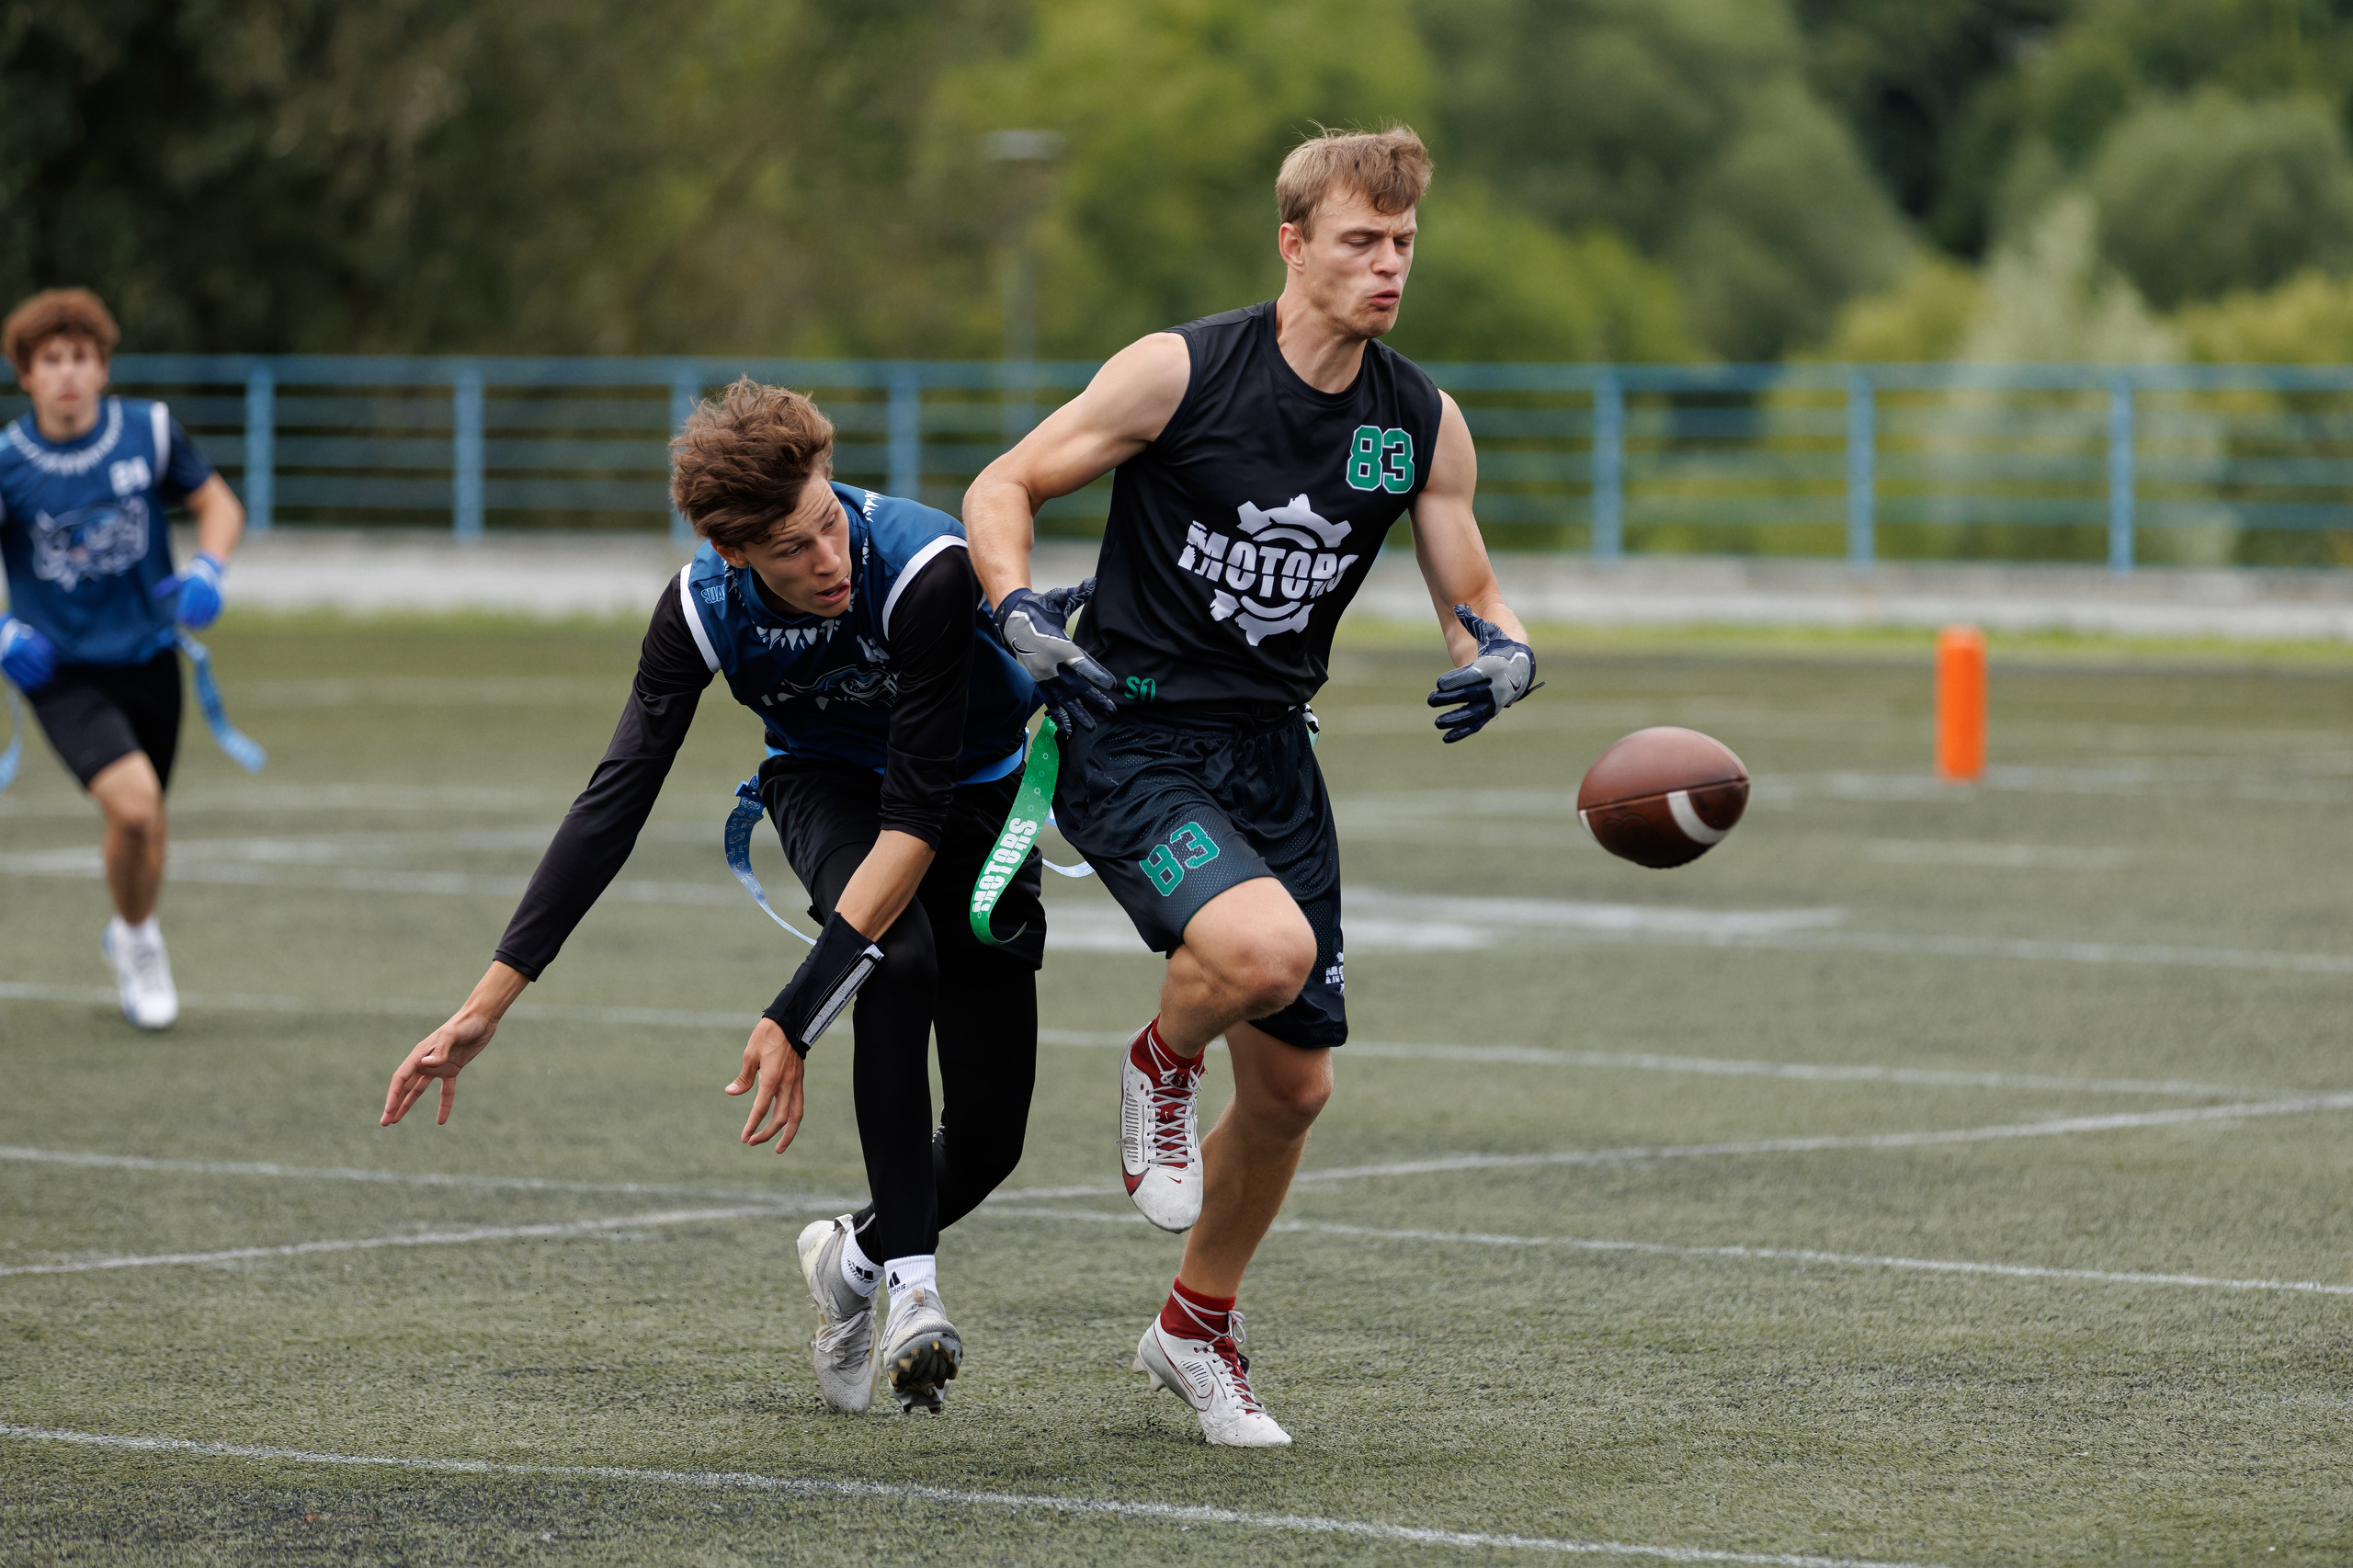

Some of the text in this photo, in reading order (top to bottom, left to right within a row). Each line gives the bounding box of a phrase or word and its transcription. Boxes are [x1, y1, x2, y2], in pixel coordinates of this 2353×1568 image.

[1346, 425, 1415, 494] 83
[972, 817, 1038, 913] MOTORS
[1139, 822, 1221, 896] 83
